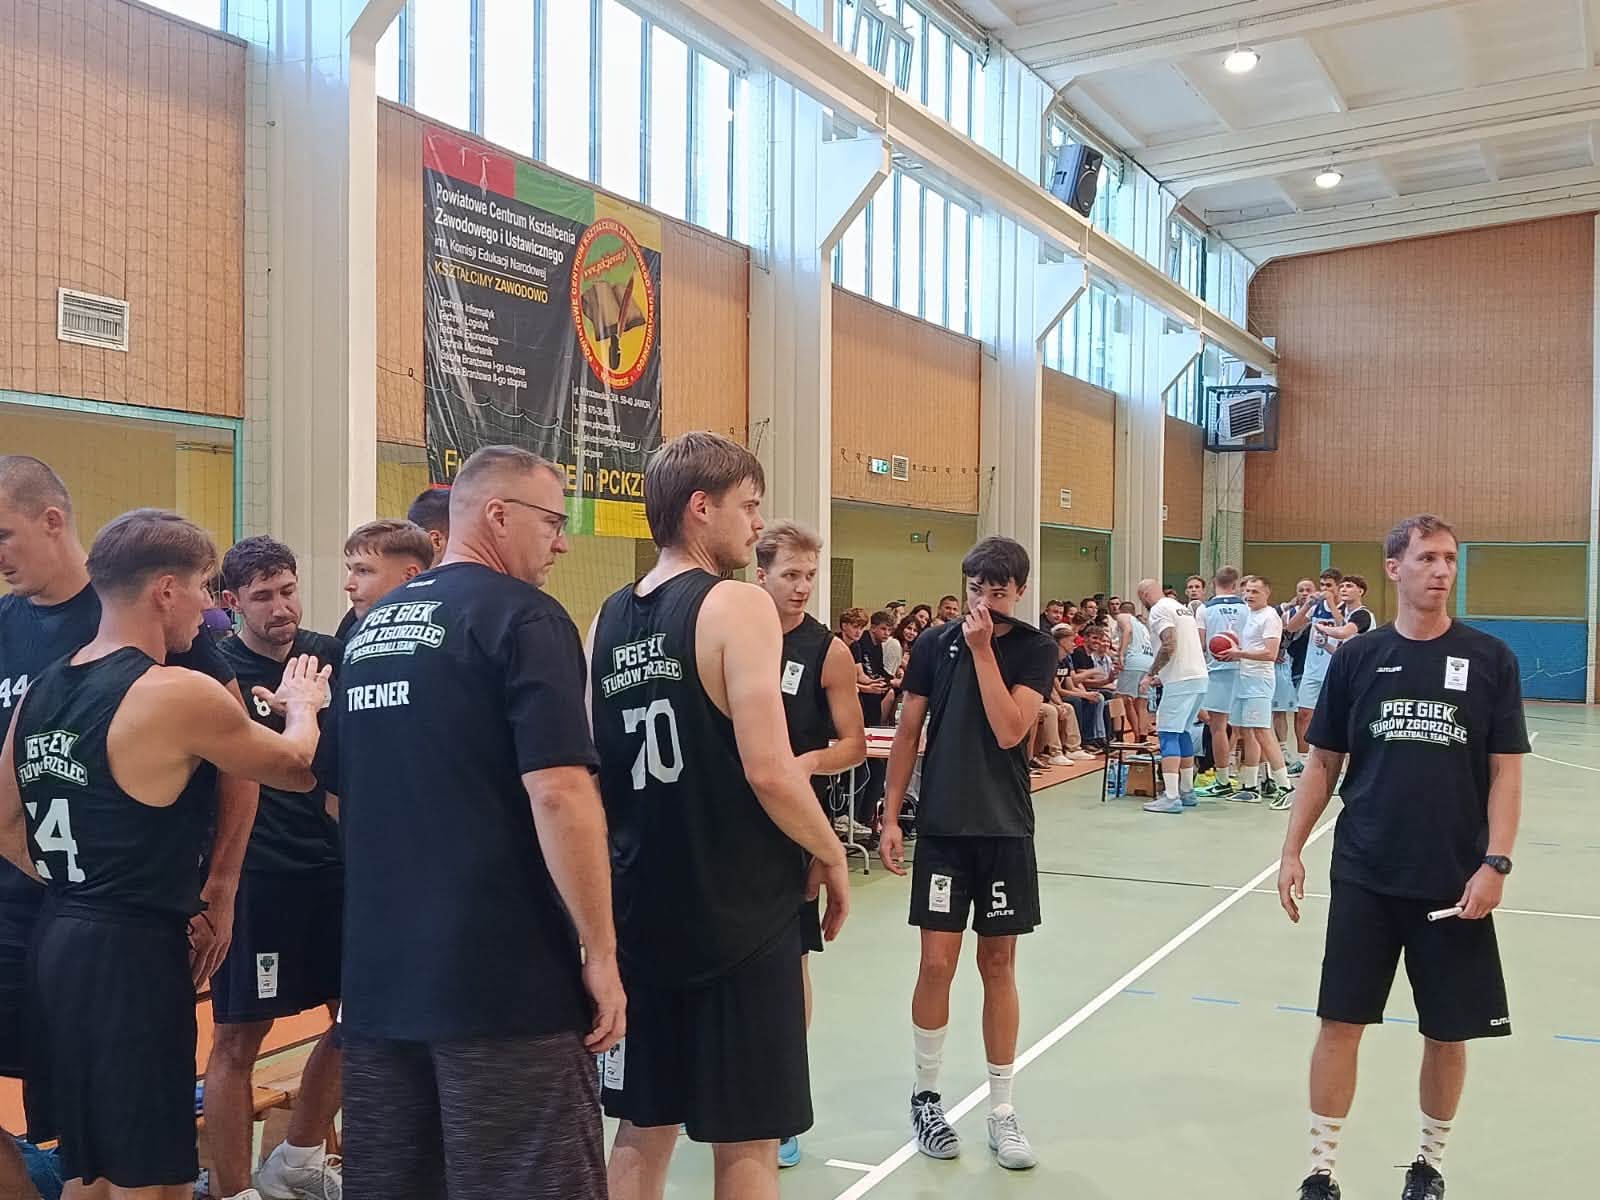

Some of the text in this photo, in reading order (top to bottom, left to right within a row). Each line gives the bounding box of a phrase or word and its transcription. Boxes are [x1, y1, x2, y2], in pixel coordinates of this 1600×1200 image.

[435, 182, 576, 245] Powiatowe Centrum Kształcenia
[435, 207, 564, 265] Zawodowego i Ustawicznego
[450, 239, 477, 260] Komisji
[478, 248, 509, 270] Edukacji
[510, 257, 547, 281] Narodowej
[434, 261, 549, 303] KSZTAŁCIMY ZAWODOWO
[584, 466, 593, 492] in
[600, 468, 645, 497] PCKZi
[362, 604, 432, 630] PGE GIEK
[376, 625, 441, 645] ZGORZELEC
[615, 642, 647, 670] PGE
[0, 674, 28, 708] 44
[603, 667, 641, 693] TURÓW
[347, 681, 409, 712] TRENER
[1383, 702, 1454, 722] PGE GIEK
[622, 698, 684, 790] 70
[1372, 717, 1467, 741] TURÓW ZGORZELEC
[992, 881, 1007, 909] 5
